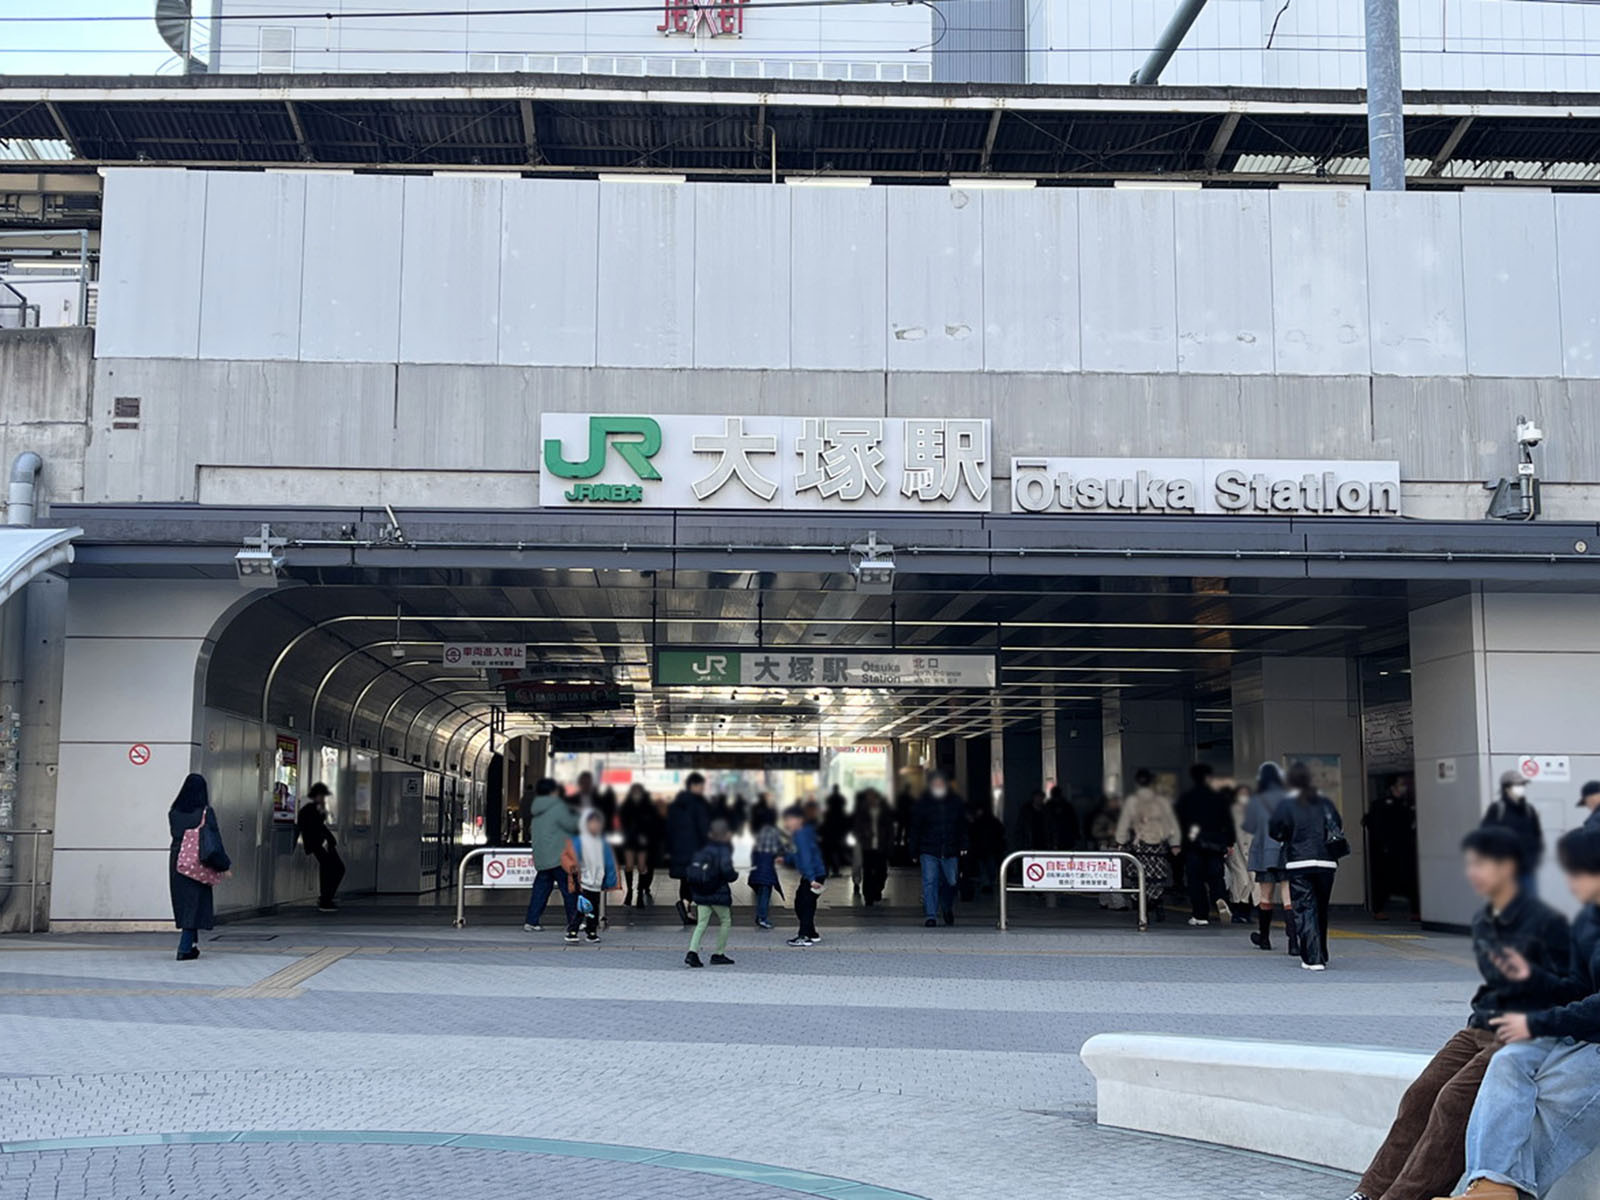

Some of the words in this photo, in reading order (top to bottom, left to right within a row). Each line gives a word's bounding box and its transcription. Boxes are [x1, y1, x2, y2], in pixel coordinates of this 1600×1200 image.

[544, 416, 662, 481] JR
[691, 416, 989, 502] 大塚駅
[564, 483, 643, 502] JR東日本
[1016, 460, 1195, 513] Ōtsuka
[1215, 469, 1398, 514] Station
[692, 655, 727, 675] JR
[754, 656, 848, 683] 大塚駅
[913, 657, 939, 668] 北口
[861, 673, 901, 684] Station
[1046, 861, 1118, 872] 自転車走行禁止
